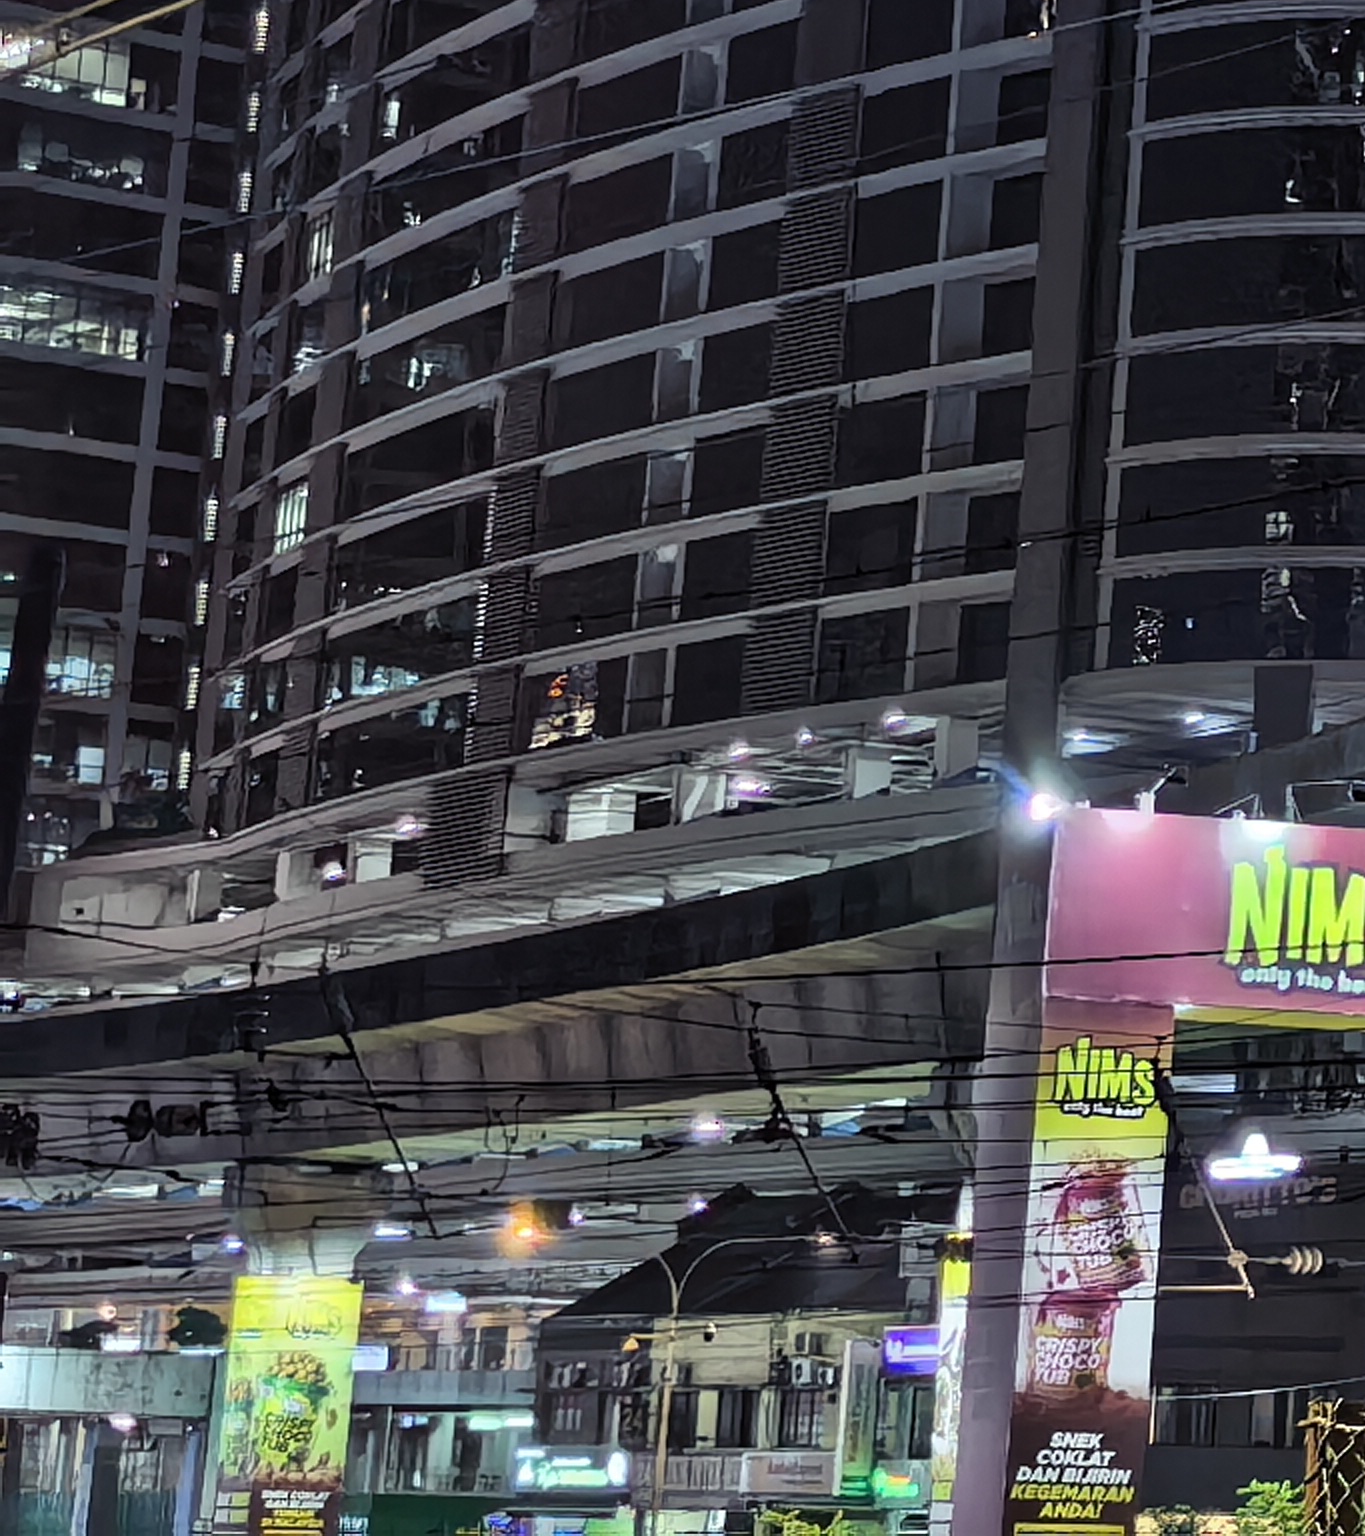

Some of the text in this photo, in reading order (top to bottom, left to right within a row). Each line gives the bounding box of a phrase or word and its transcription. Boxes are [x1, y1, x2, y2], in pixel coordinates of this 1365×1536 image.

[1055, 1037, 1156, 1105] NIMS
[1050, 1431, 1104, 1449] SNEK
[1036, 1449, 1116, 1467] COKLAT
[1015, 1466, 1059, 1484] DAN
[1010, 1484, 1134, 1503] KEGEMARAN
[1037, 1502, 1104, 1519] ANDA!
